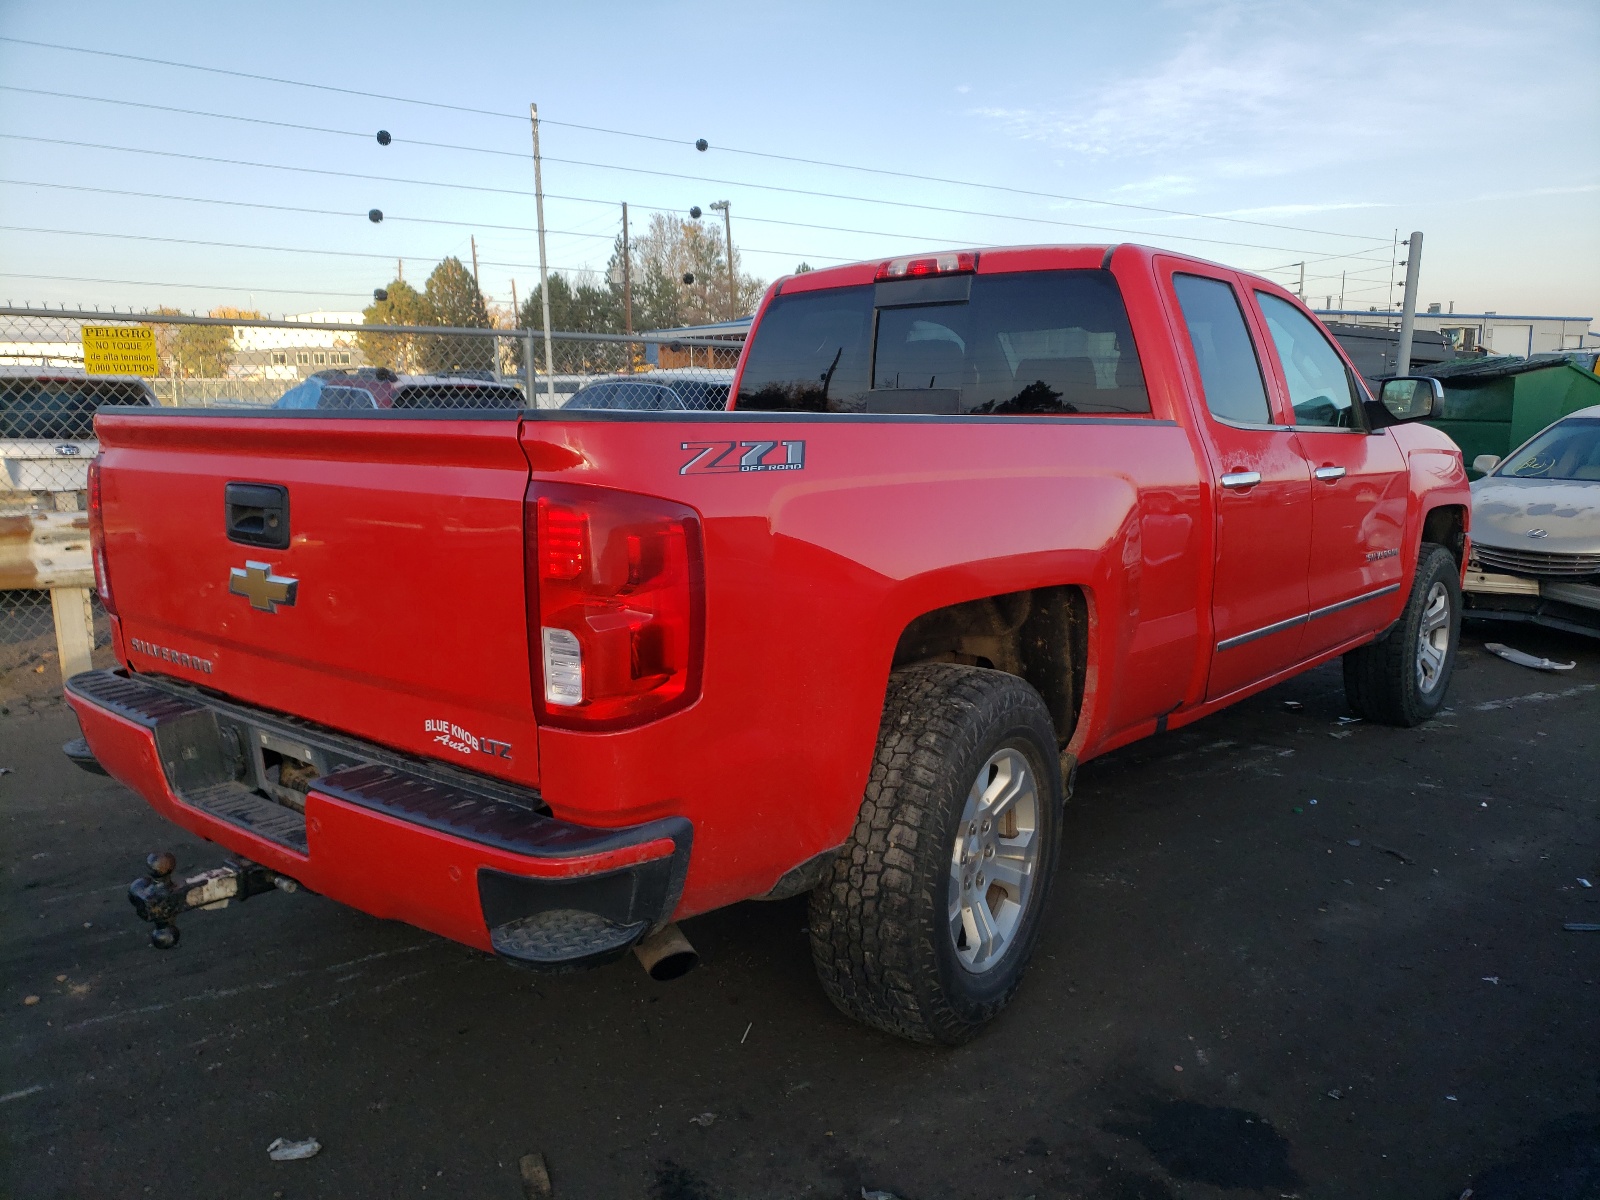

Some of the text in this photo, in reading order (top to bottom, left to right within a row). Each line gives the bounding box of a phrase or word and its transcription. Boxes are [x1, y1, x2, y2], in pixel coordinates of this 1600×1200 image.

[84, 328, 151, 338] PELIGRO
[95, 341, 143, 350] NO TOQUE
[90, 352, 101, 361] de
[103, 352, 119, 361] alta
[112, 363, 155, 373] VOLTIOS
[679, 441, 806, 475] Z71
[768, 463, 802, 472] ROAD
[131, 638, 213, 674] SILVERADO
[425, 719, 479, 751] BLUE KNOB
[433, 734, 471, 754] Auto
[480, 736, 513, 760] LTZ
